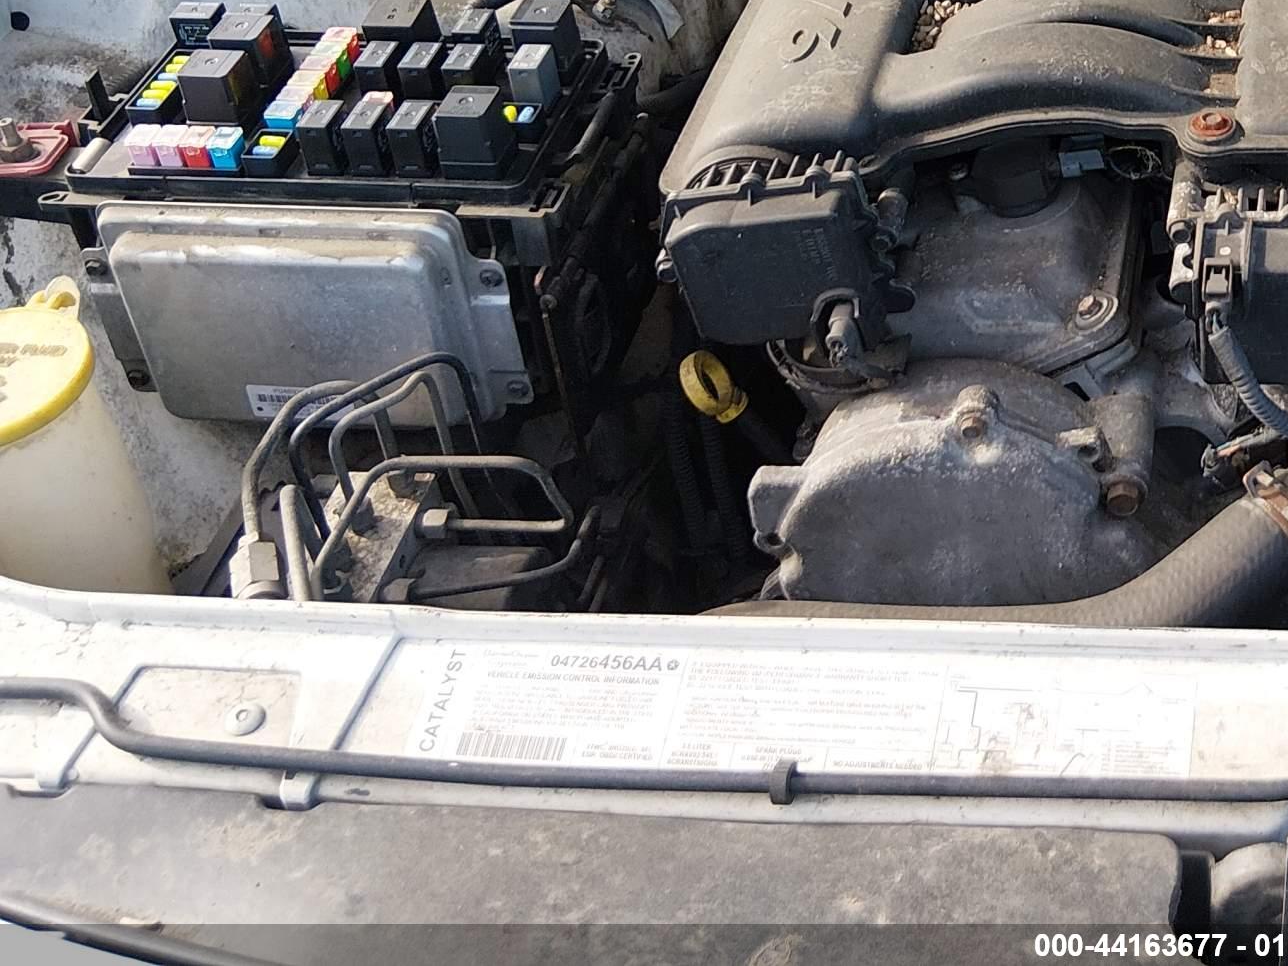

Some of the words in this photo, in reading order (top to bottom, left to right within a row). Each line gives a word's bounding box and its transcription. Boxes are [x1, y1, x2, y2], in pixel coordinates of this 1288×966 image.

[550, 654, 662, 672] 04726456AA
[487, 671, 521, 680] VEHICLE
[522, 672, 562, 682] EMISSION
[562, 674, 601, 683] CONTROL
[602, 675, 661, 686] INFORMATION
[419, 649, 466, 753] CATALYST
